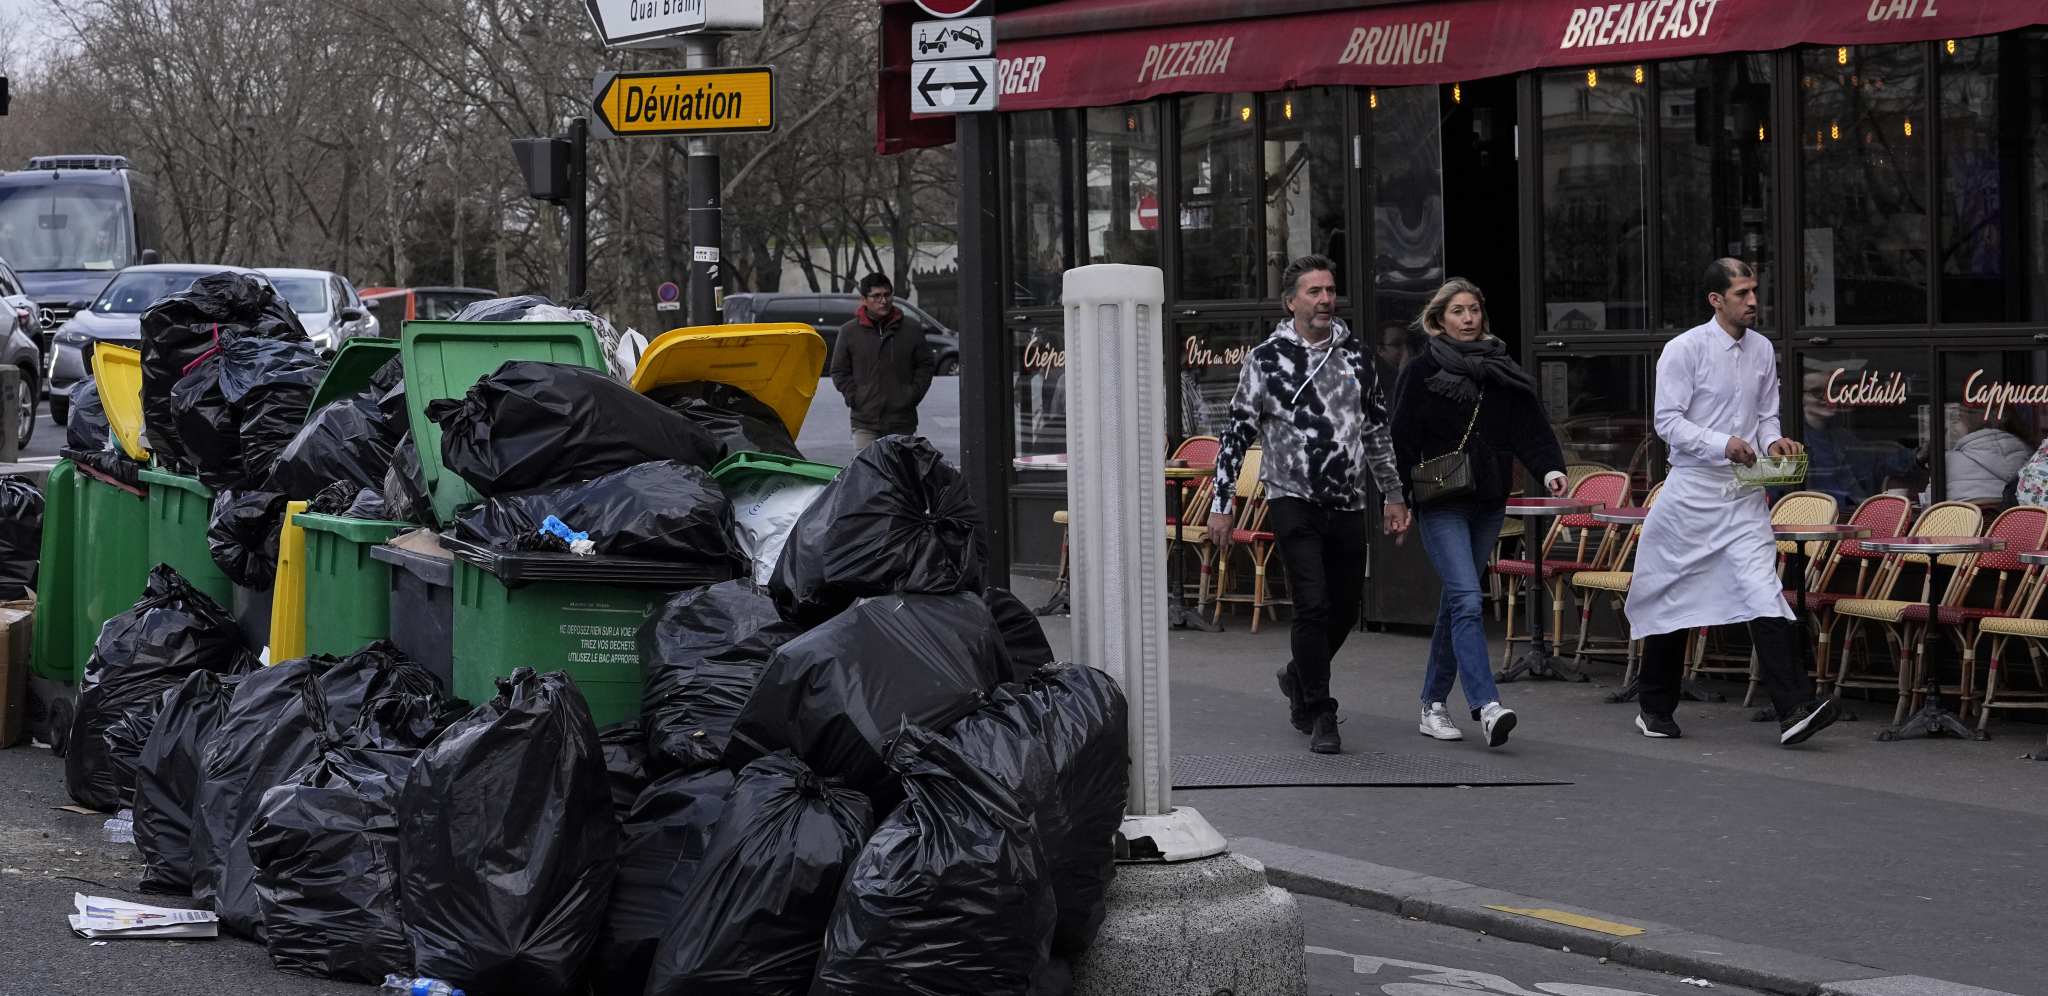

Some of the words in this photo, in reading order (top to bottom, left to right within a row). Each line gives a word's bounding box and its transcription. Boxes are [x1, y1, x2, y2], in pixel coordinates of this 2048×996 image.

[630, 0, 657, 21] Quai
[1560, 0, 1722, 49] BREAKFAST
[1137, 37, 1235, 83] PIZZERIA
[1338, 20, 1450, 65] BRUNCH
[998, 55, 1047, 95] RGER
[625, 83, 742, 123] Déviation
[1186, 335, 1212, 368] Vin
[1213, 353, 1223, 365] au
[1826, 367, 1907, 407] Cocktails
[567, 625, 590, 635] DEPOSEZ
[602, 626, 613, 636] SUR
[613, 627, 620, 636] LA
[581, 639, 596, 649] TRIEZ
[597, 640, 609, 649] VOS
[610, 640, 635, 650] DECHETS
[568, 652, 591, 662] UTILISEZ
[591, 653, 598, 662] LE
[599, 653, 610, 663] BAC
